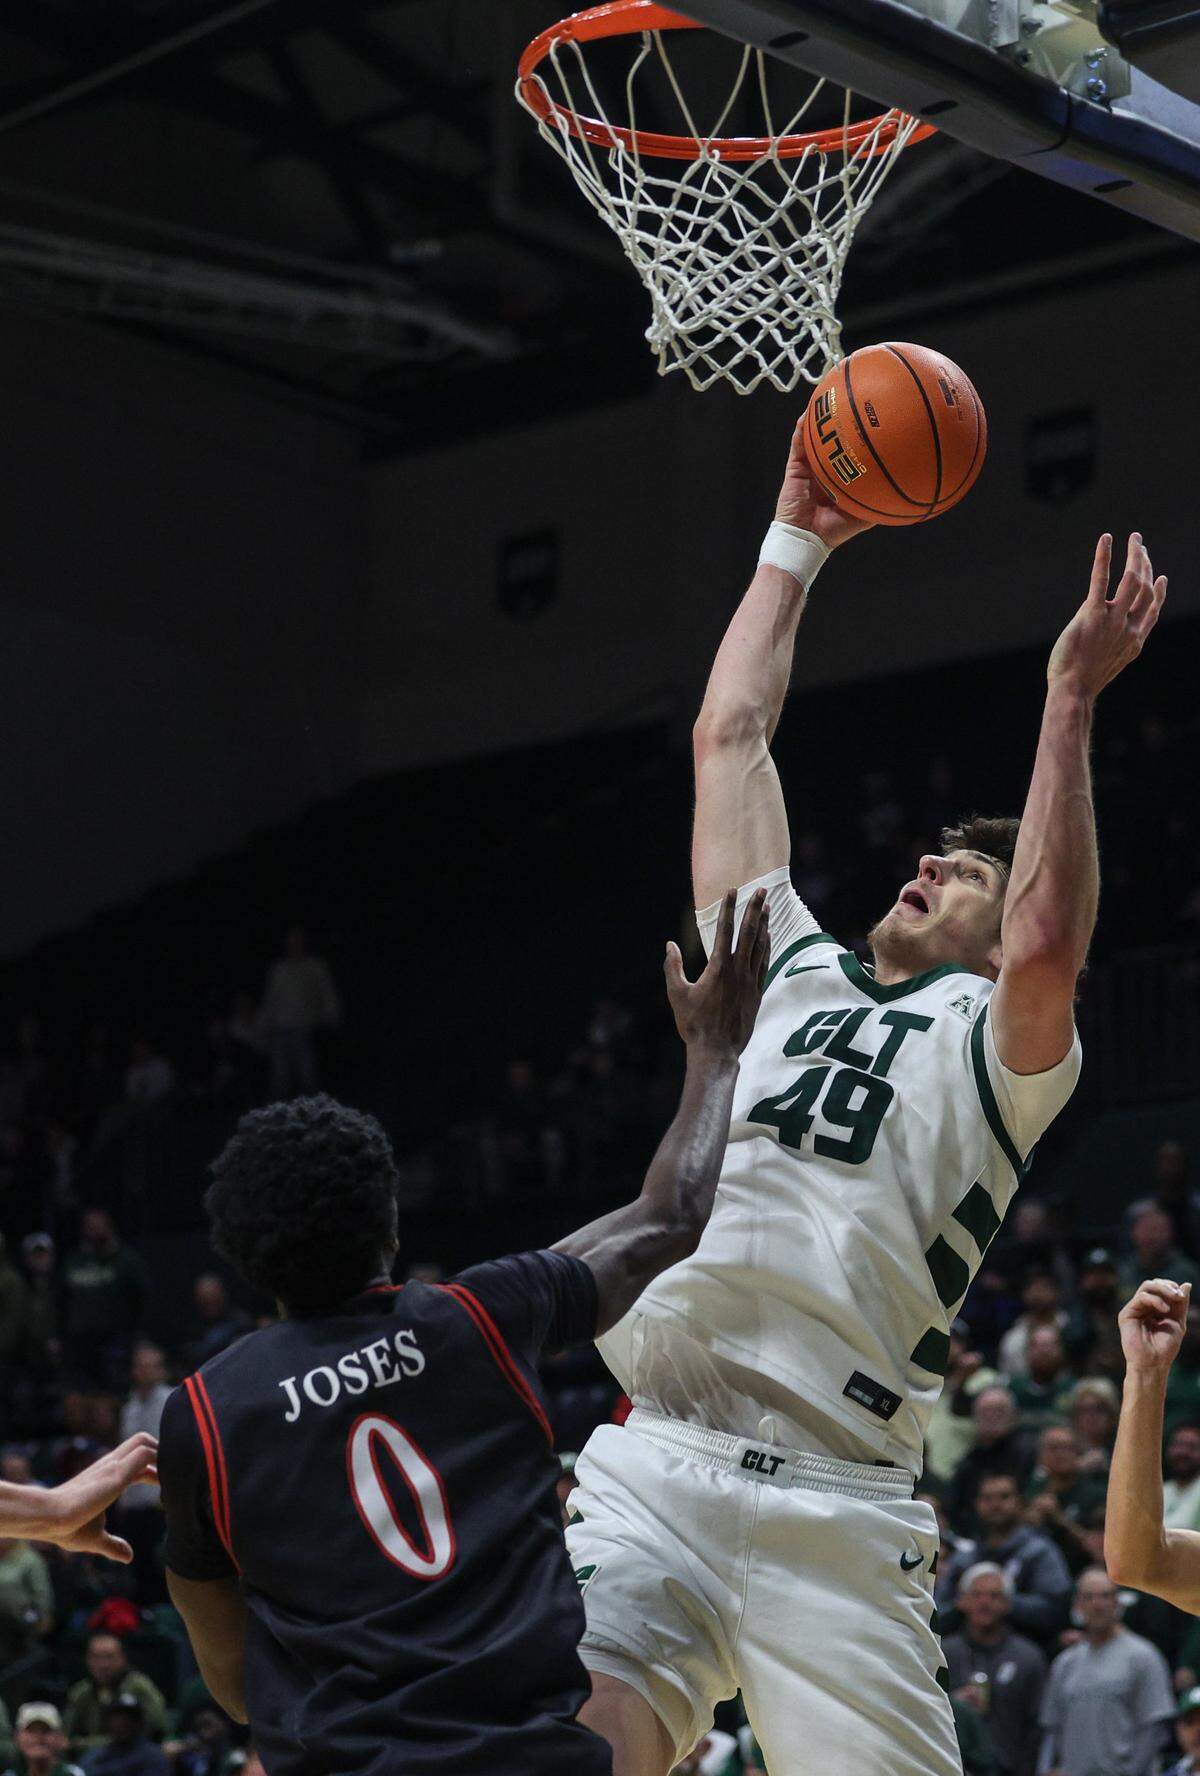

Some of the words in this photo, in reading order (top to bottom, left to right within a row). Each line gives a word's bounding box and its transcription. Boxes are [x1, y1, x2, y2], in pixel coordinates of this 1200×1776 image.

[815, 389, 861, 485] ELITE
[746, 1065, 895, 1165] 49
[278, 1328, 427, 1423] JOSES
[879, 1397, 889, 1412] XL
[345, 1411, 456, 1581] 0
